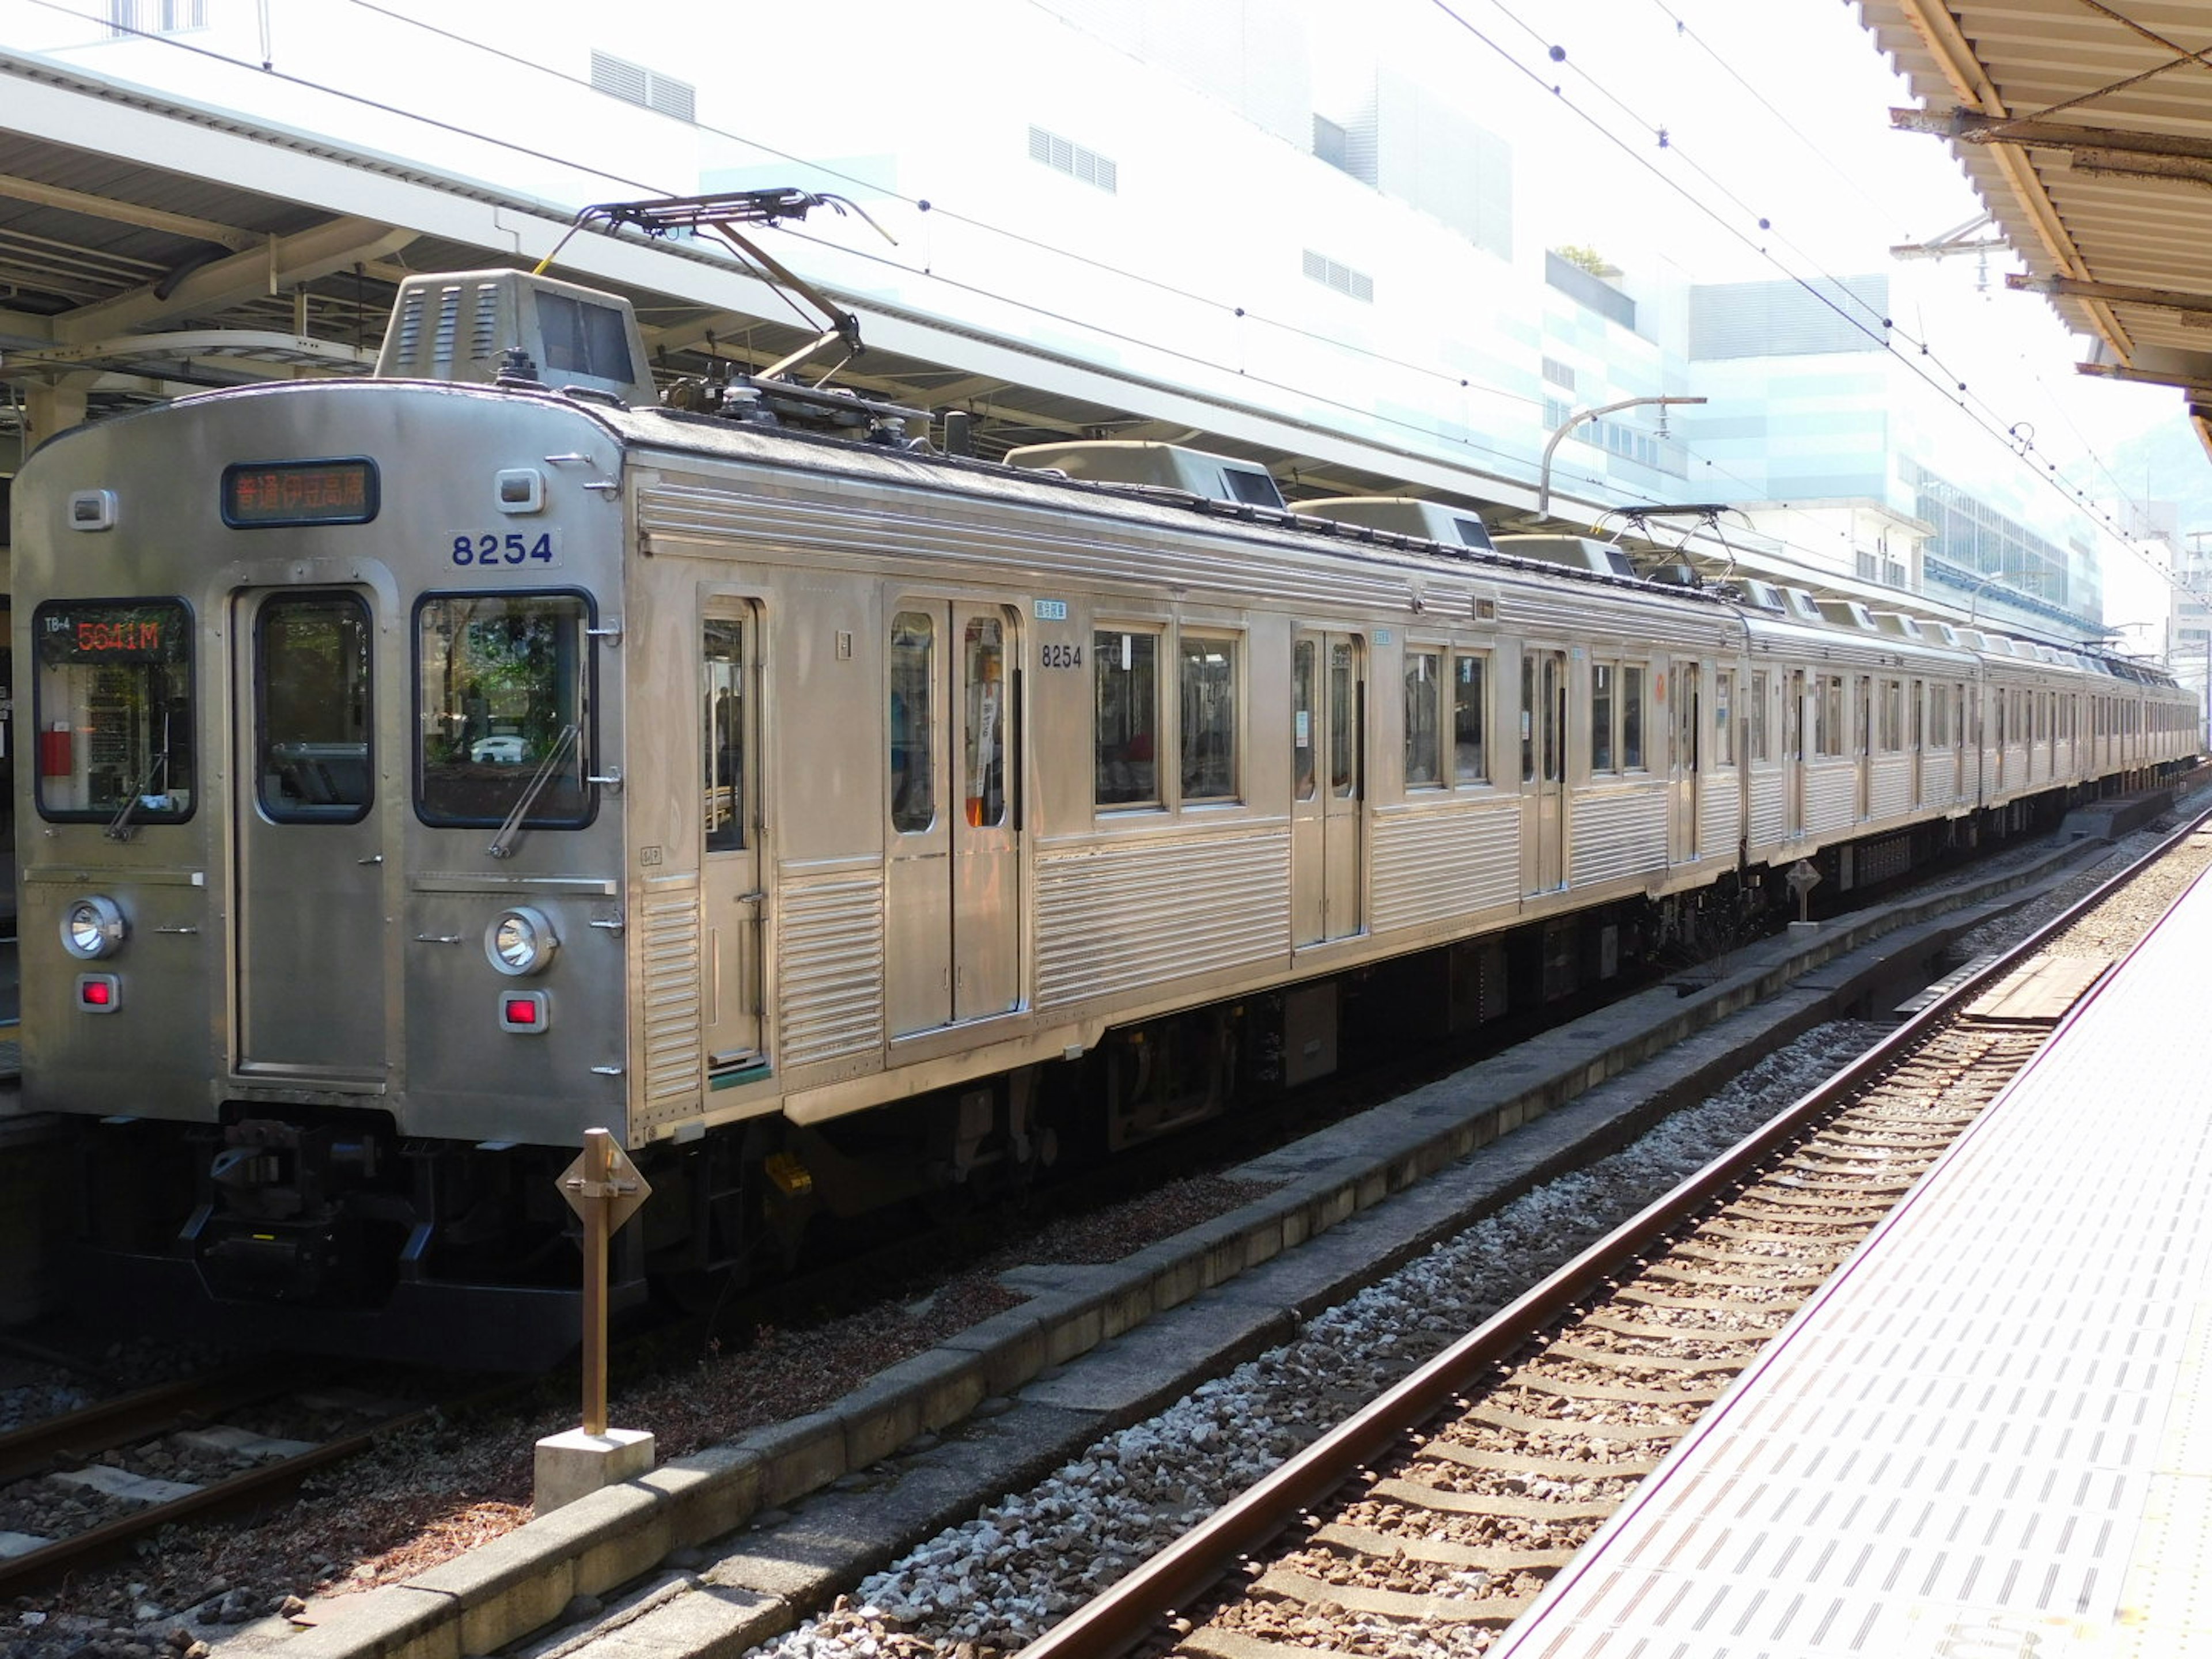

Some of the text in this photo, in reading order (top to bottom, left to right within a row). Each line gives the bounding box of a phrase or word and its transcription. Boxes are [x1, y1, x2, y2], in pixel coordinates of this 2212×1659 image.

[452, 533, 552, 565] 8254
[44, 616, 70, 632] TB-4
[78, 621, 159, 650] 5641M
[1042, 645, 1081, 668] 8254
